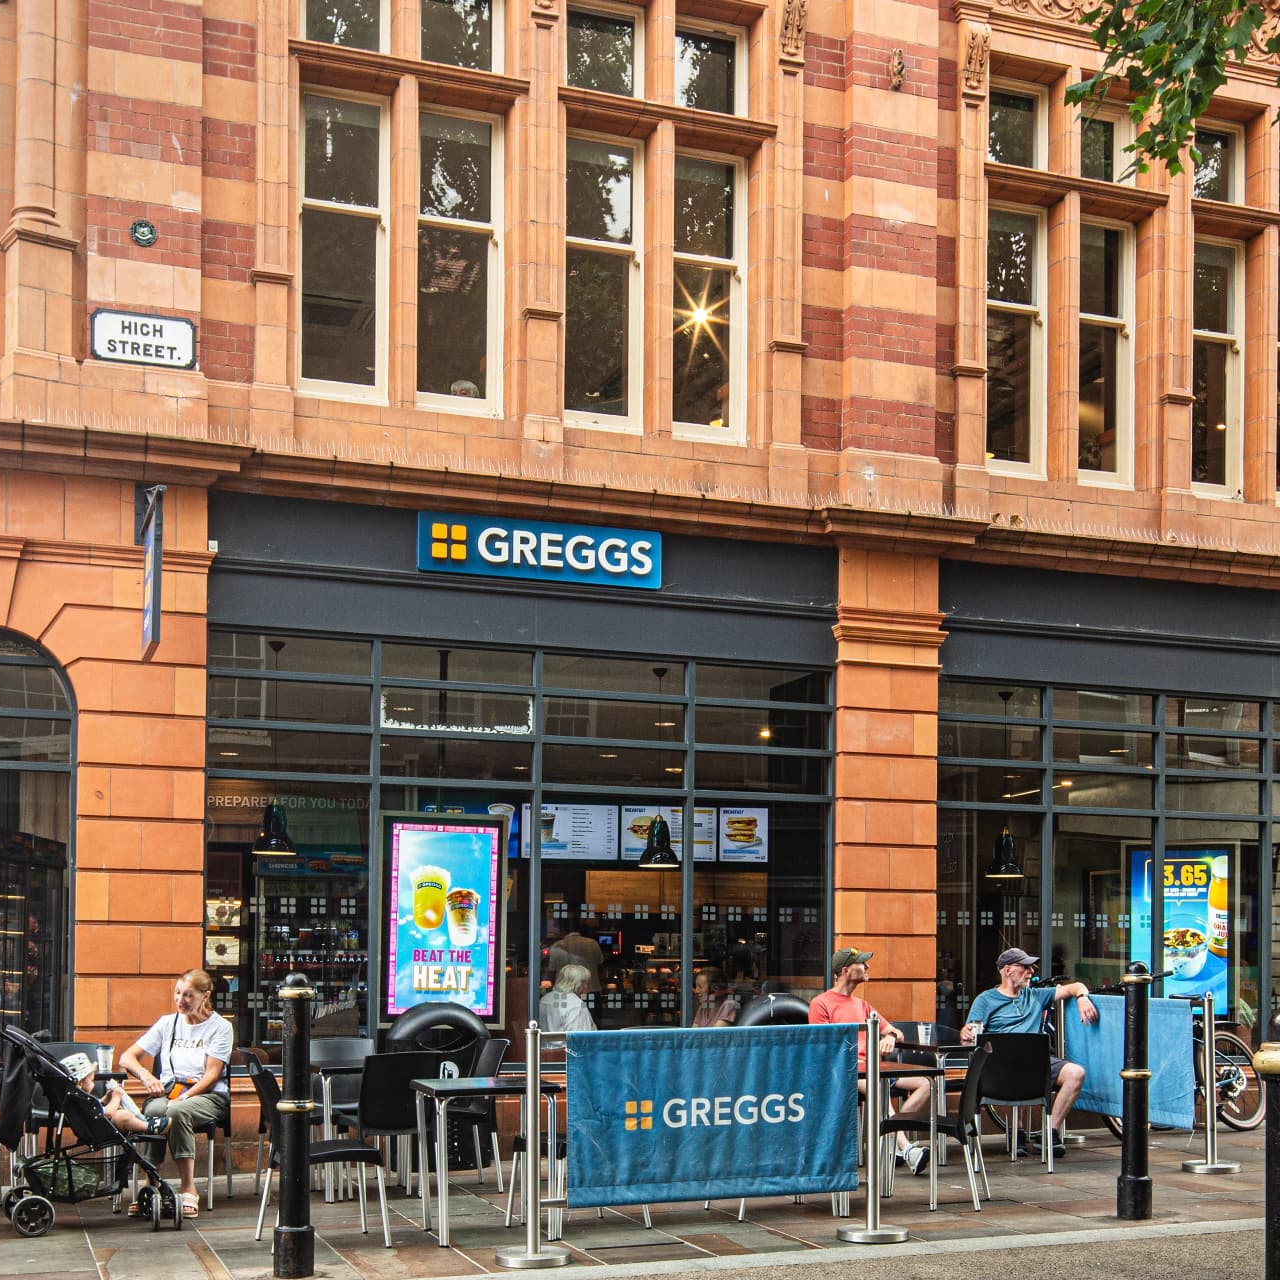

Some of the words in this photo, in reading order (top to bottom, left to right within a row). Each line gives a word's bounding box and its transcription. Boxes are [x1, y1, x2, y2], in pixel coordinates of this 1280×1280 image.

[121, 320, 163, 338] HIGH
[107, 339, 181, 360] STREET.
[477, 527, 653, 575] GREGGS
[281, 797, 306, 809] FOR
[309, 797, 336, 809] YOU
[1164, 864, 1207, 886] 3.65
[413, 949, 444, 962] BEAT
[449, 950, 472, 963] THE
[413, 965, 472, 992] HEAT
[662, 1093, 805, 1128] GREGGS
